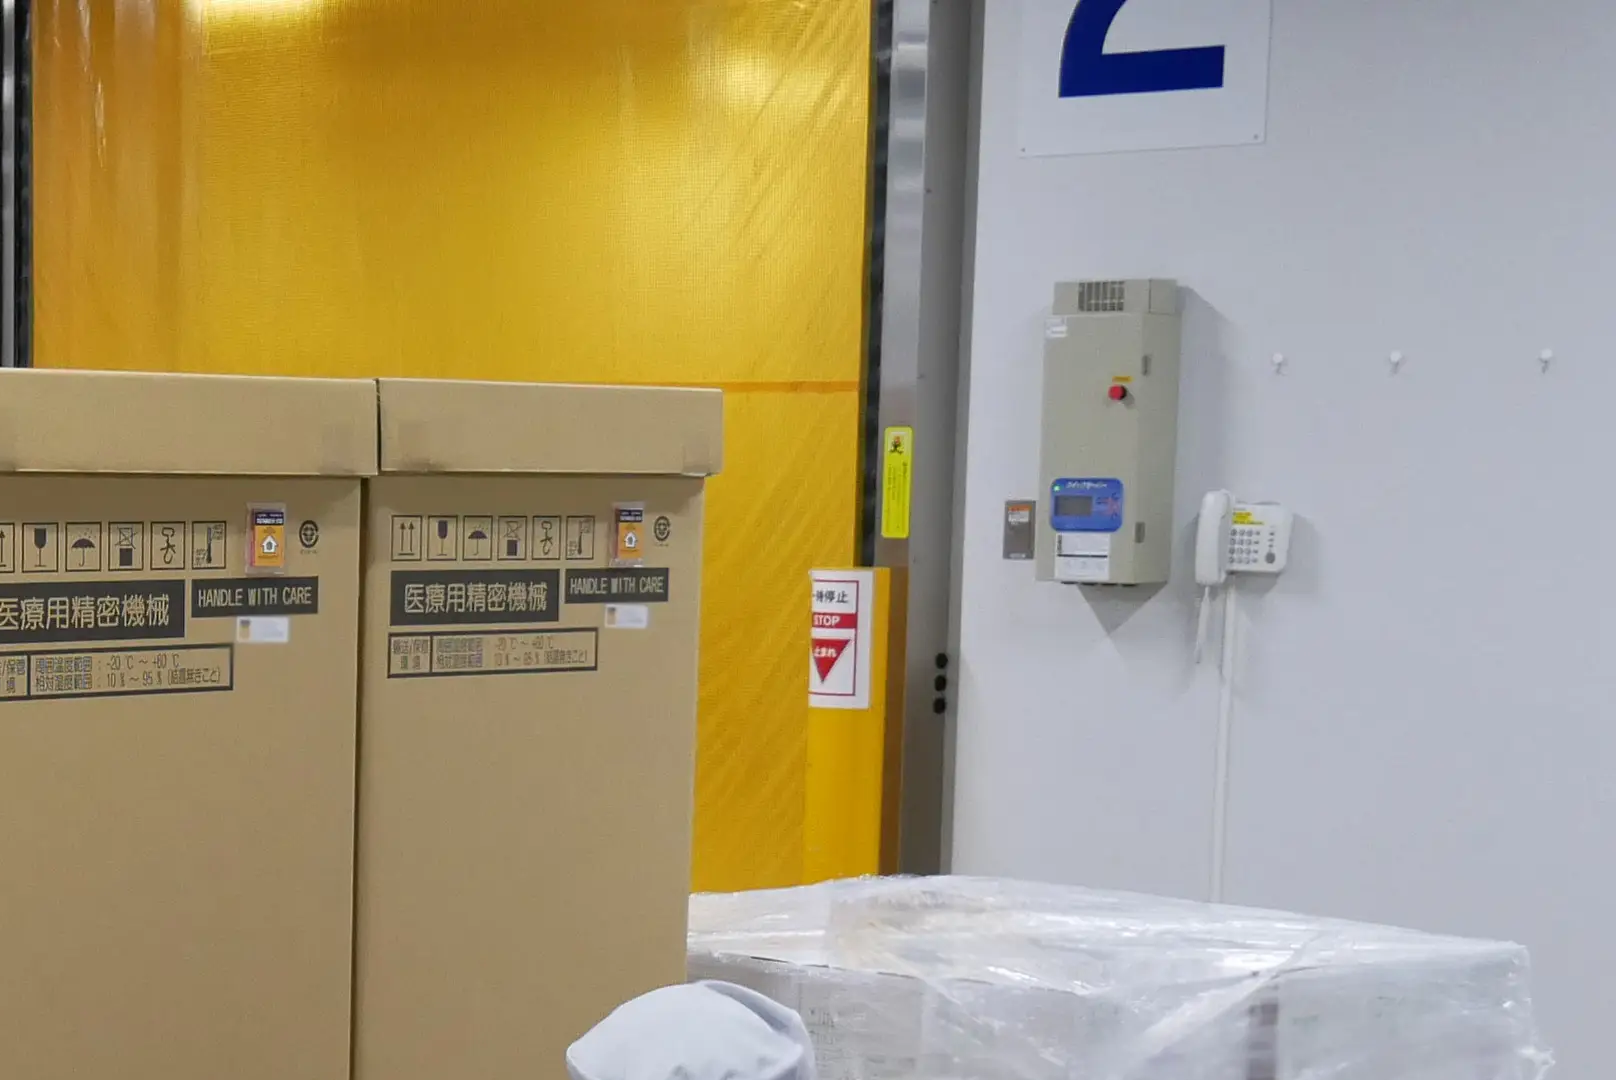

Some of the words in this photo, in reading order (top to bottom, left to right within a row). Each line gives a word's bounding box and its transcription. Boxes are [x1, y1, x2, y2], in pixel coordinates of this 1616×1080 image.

[570, 577, 606, 595] HANDLE
[611, 576, 635, 594] WITH
[640, 575, 664, 592] CARE
[198, 588, 243, 608] HANDLE
[248, 587, 278, 606] WITH
[283, 586, 312, 605] CARE
[405, 581, 547, 613] 医療用精密機械
